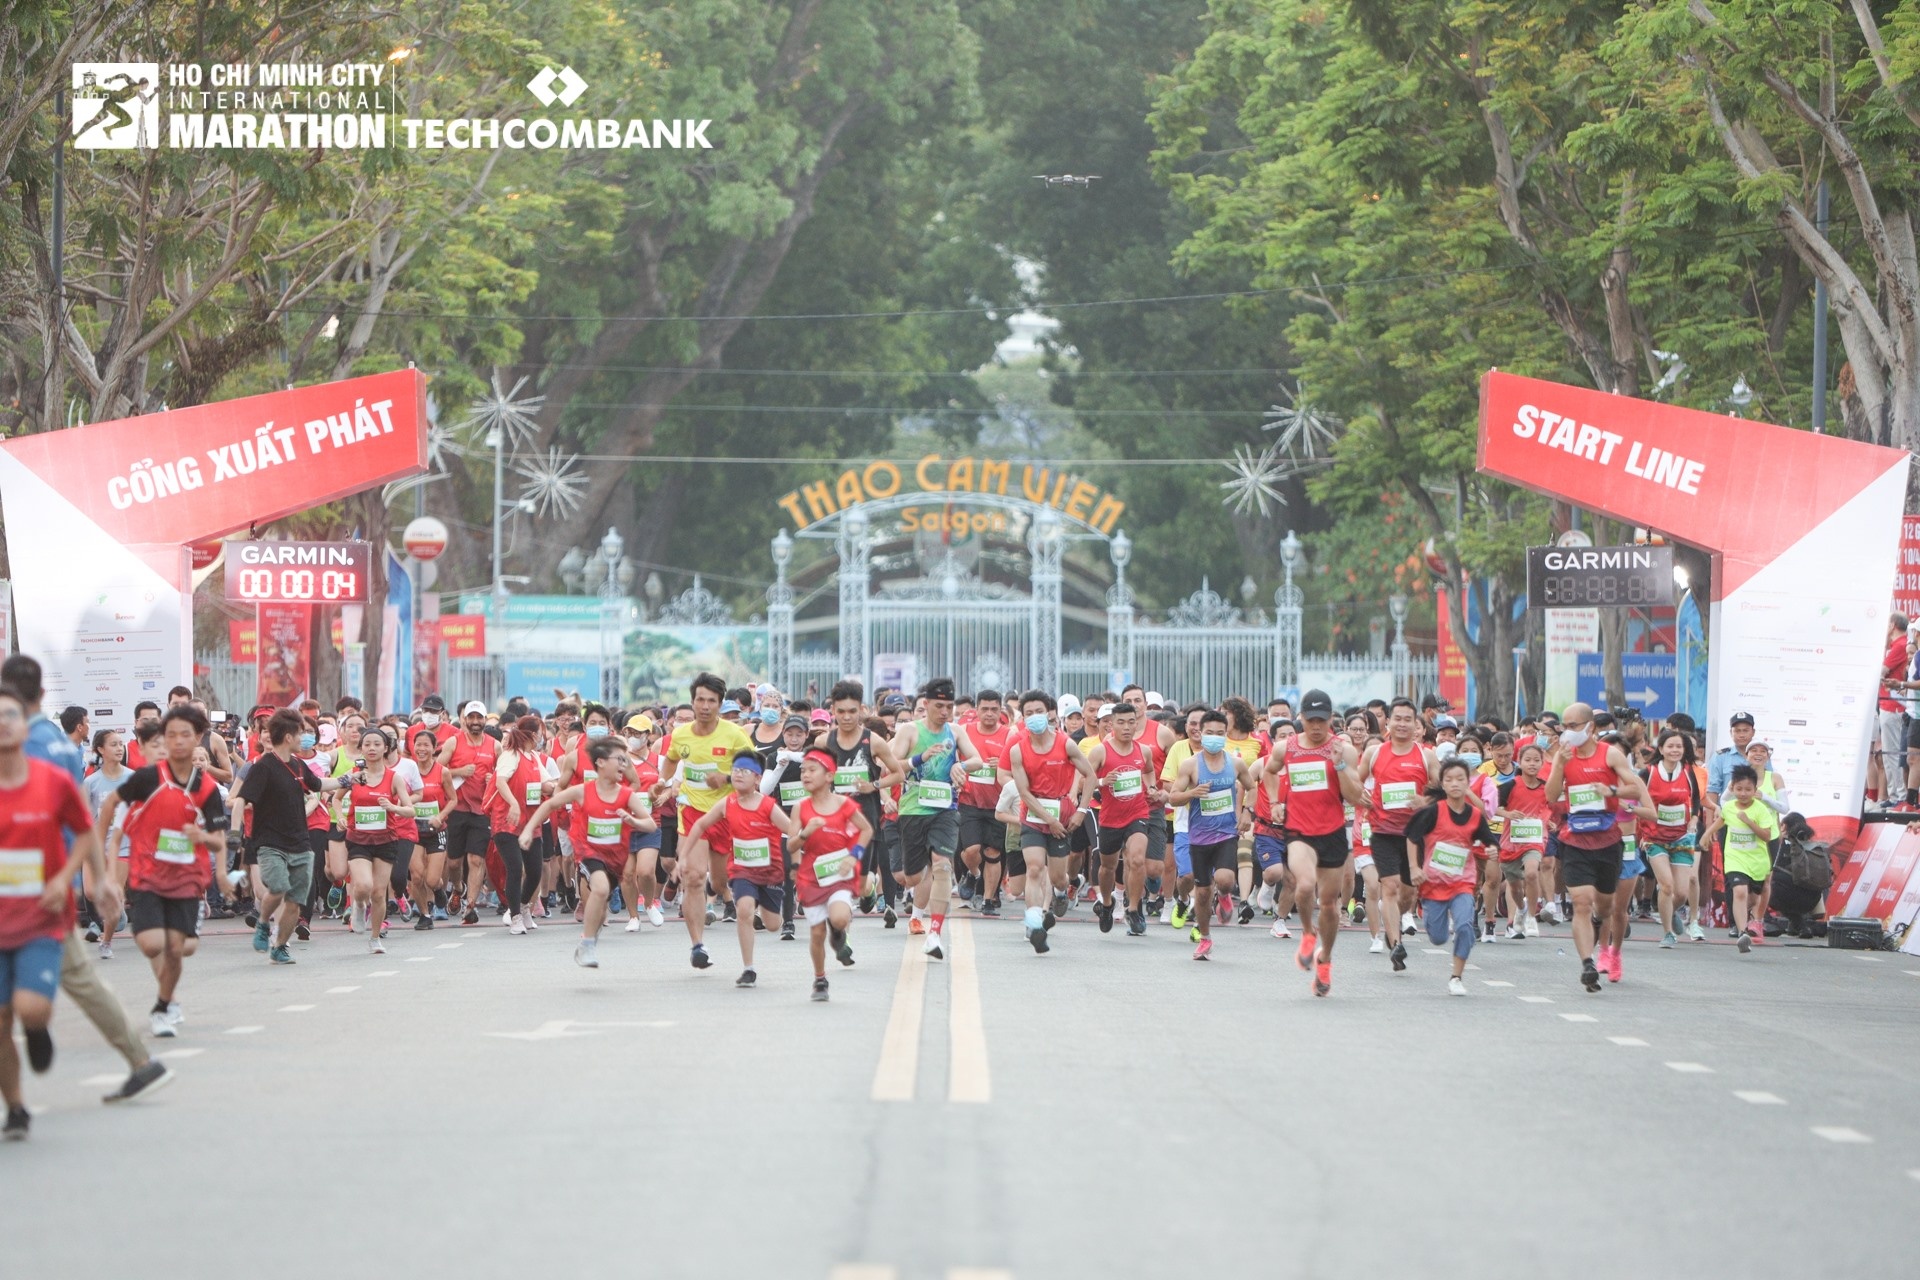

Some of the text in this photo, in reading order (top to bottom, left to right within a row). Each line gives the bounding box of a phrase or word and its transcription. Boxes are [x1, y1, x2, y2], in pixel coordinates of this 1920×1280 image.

[107, 398, 394, 510] CỔNG XUẤT PHÁT
[1512, 404, 1706, 496] START LINE
[915, 453, 1011, 496] CAM
[900, 506, 1008, 538] Saigon
[1627, 661, 1650, 678] NGUYỄN
[926, 789, 946, 798] 7019
[1575, 792, 1595, 800] 7017
[1205, 799, 1228, 809] 10075
[417, 807, 433, 815] 7184
[361, 813, 379, 821] 7187
[740, 849, 761, 858] 7088
